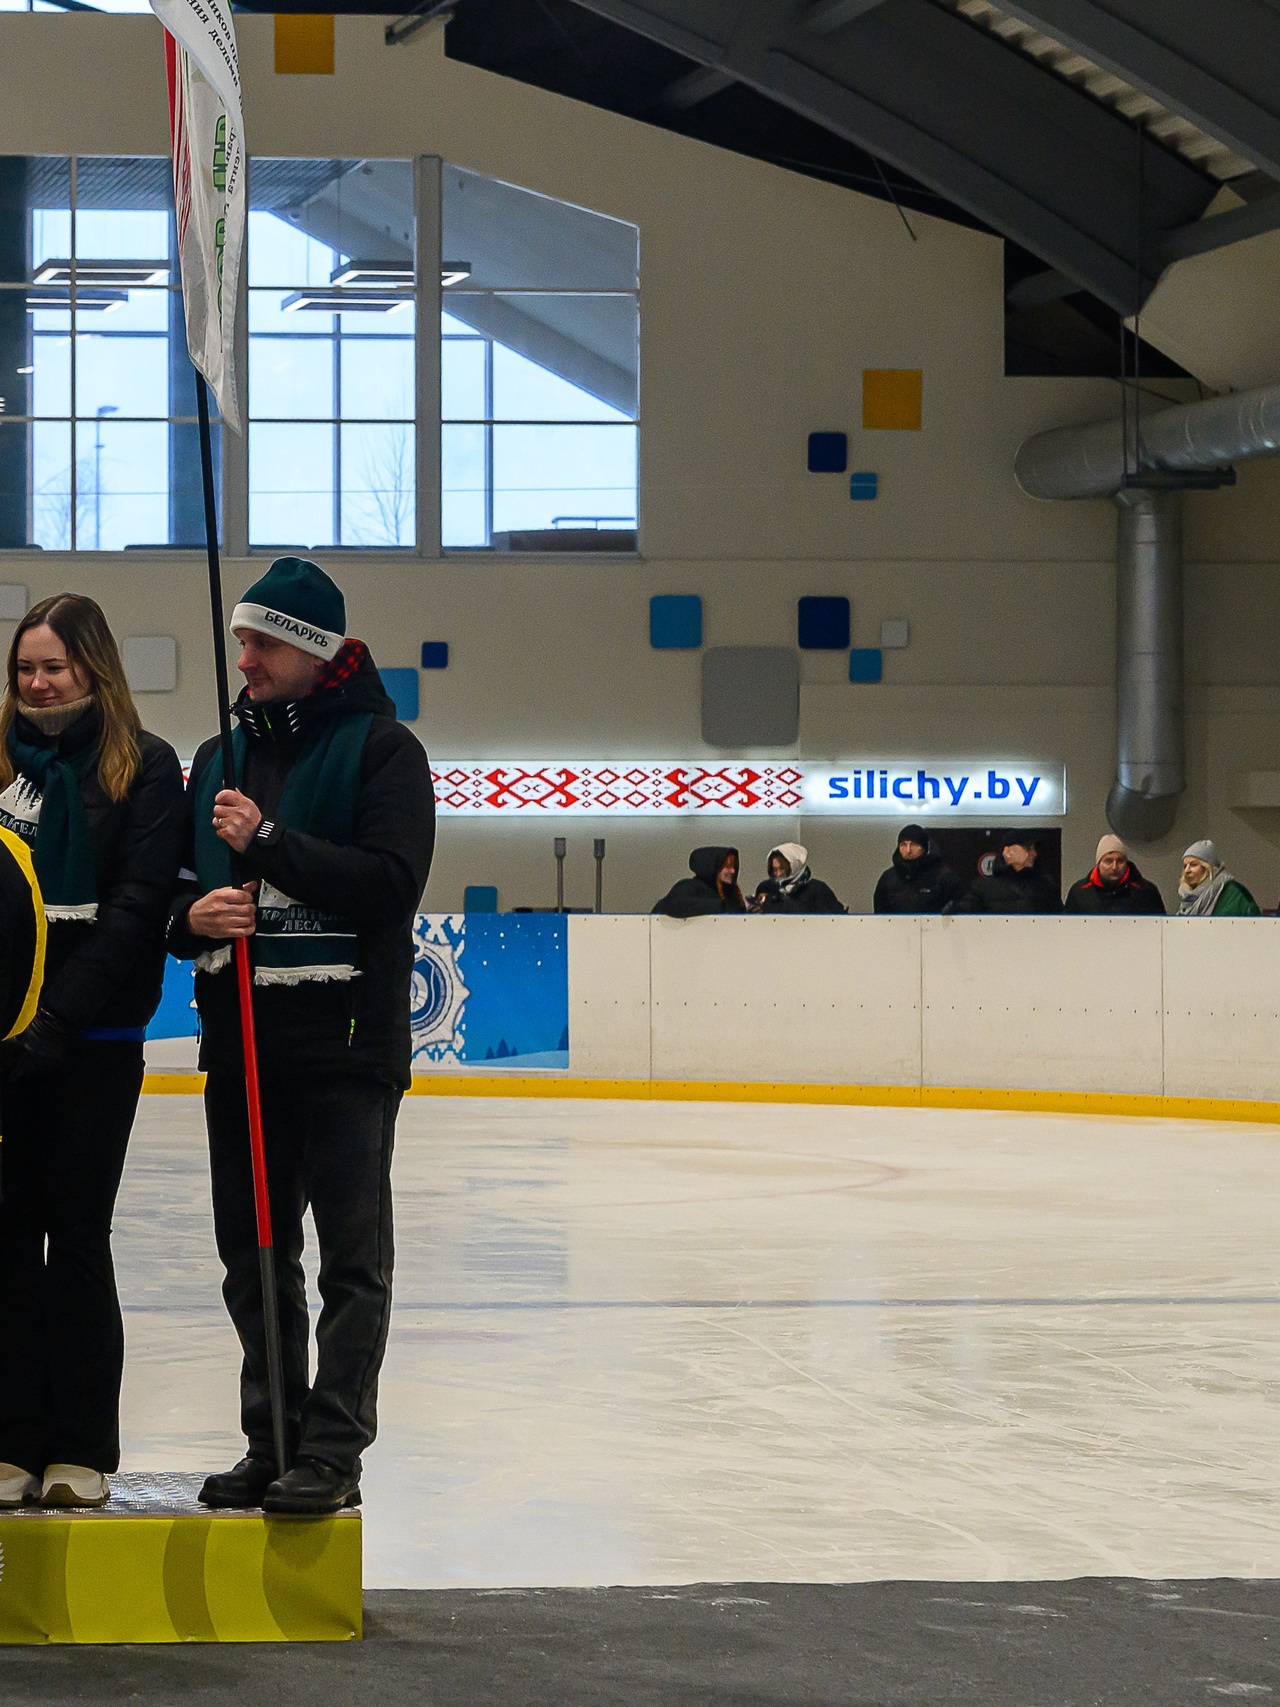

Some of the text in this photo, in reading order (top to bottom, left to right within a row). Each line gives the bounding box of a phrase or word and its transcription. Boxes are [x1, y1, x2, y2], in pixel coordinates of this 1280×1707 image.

[208, 29, 239, 88] делами
[265, 610, 328, 648] БЕЛАРУСЬ
[828, 769, 1042, 807] silichy.by
[282, 919, 322, 932] ЛЕСА
